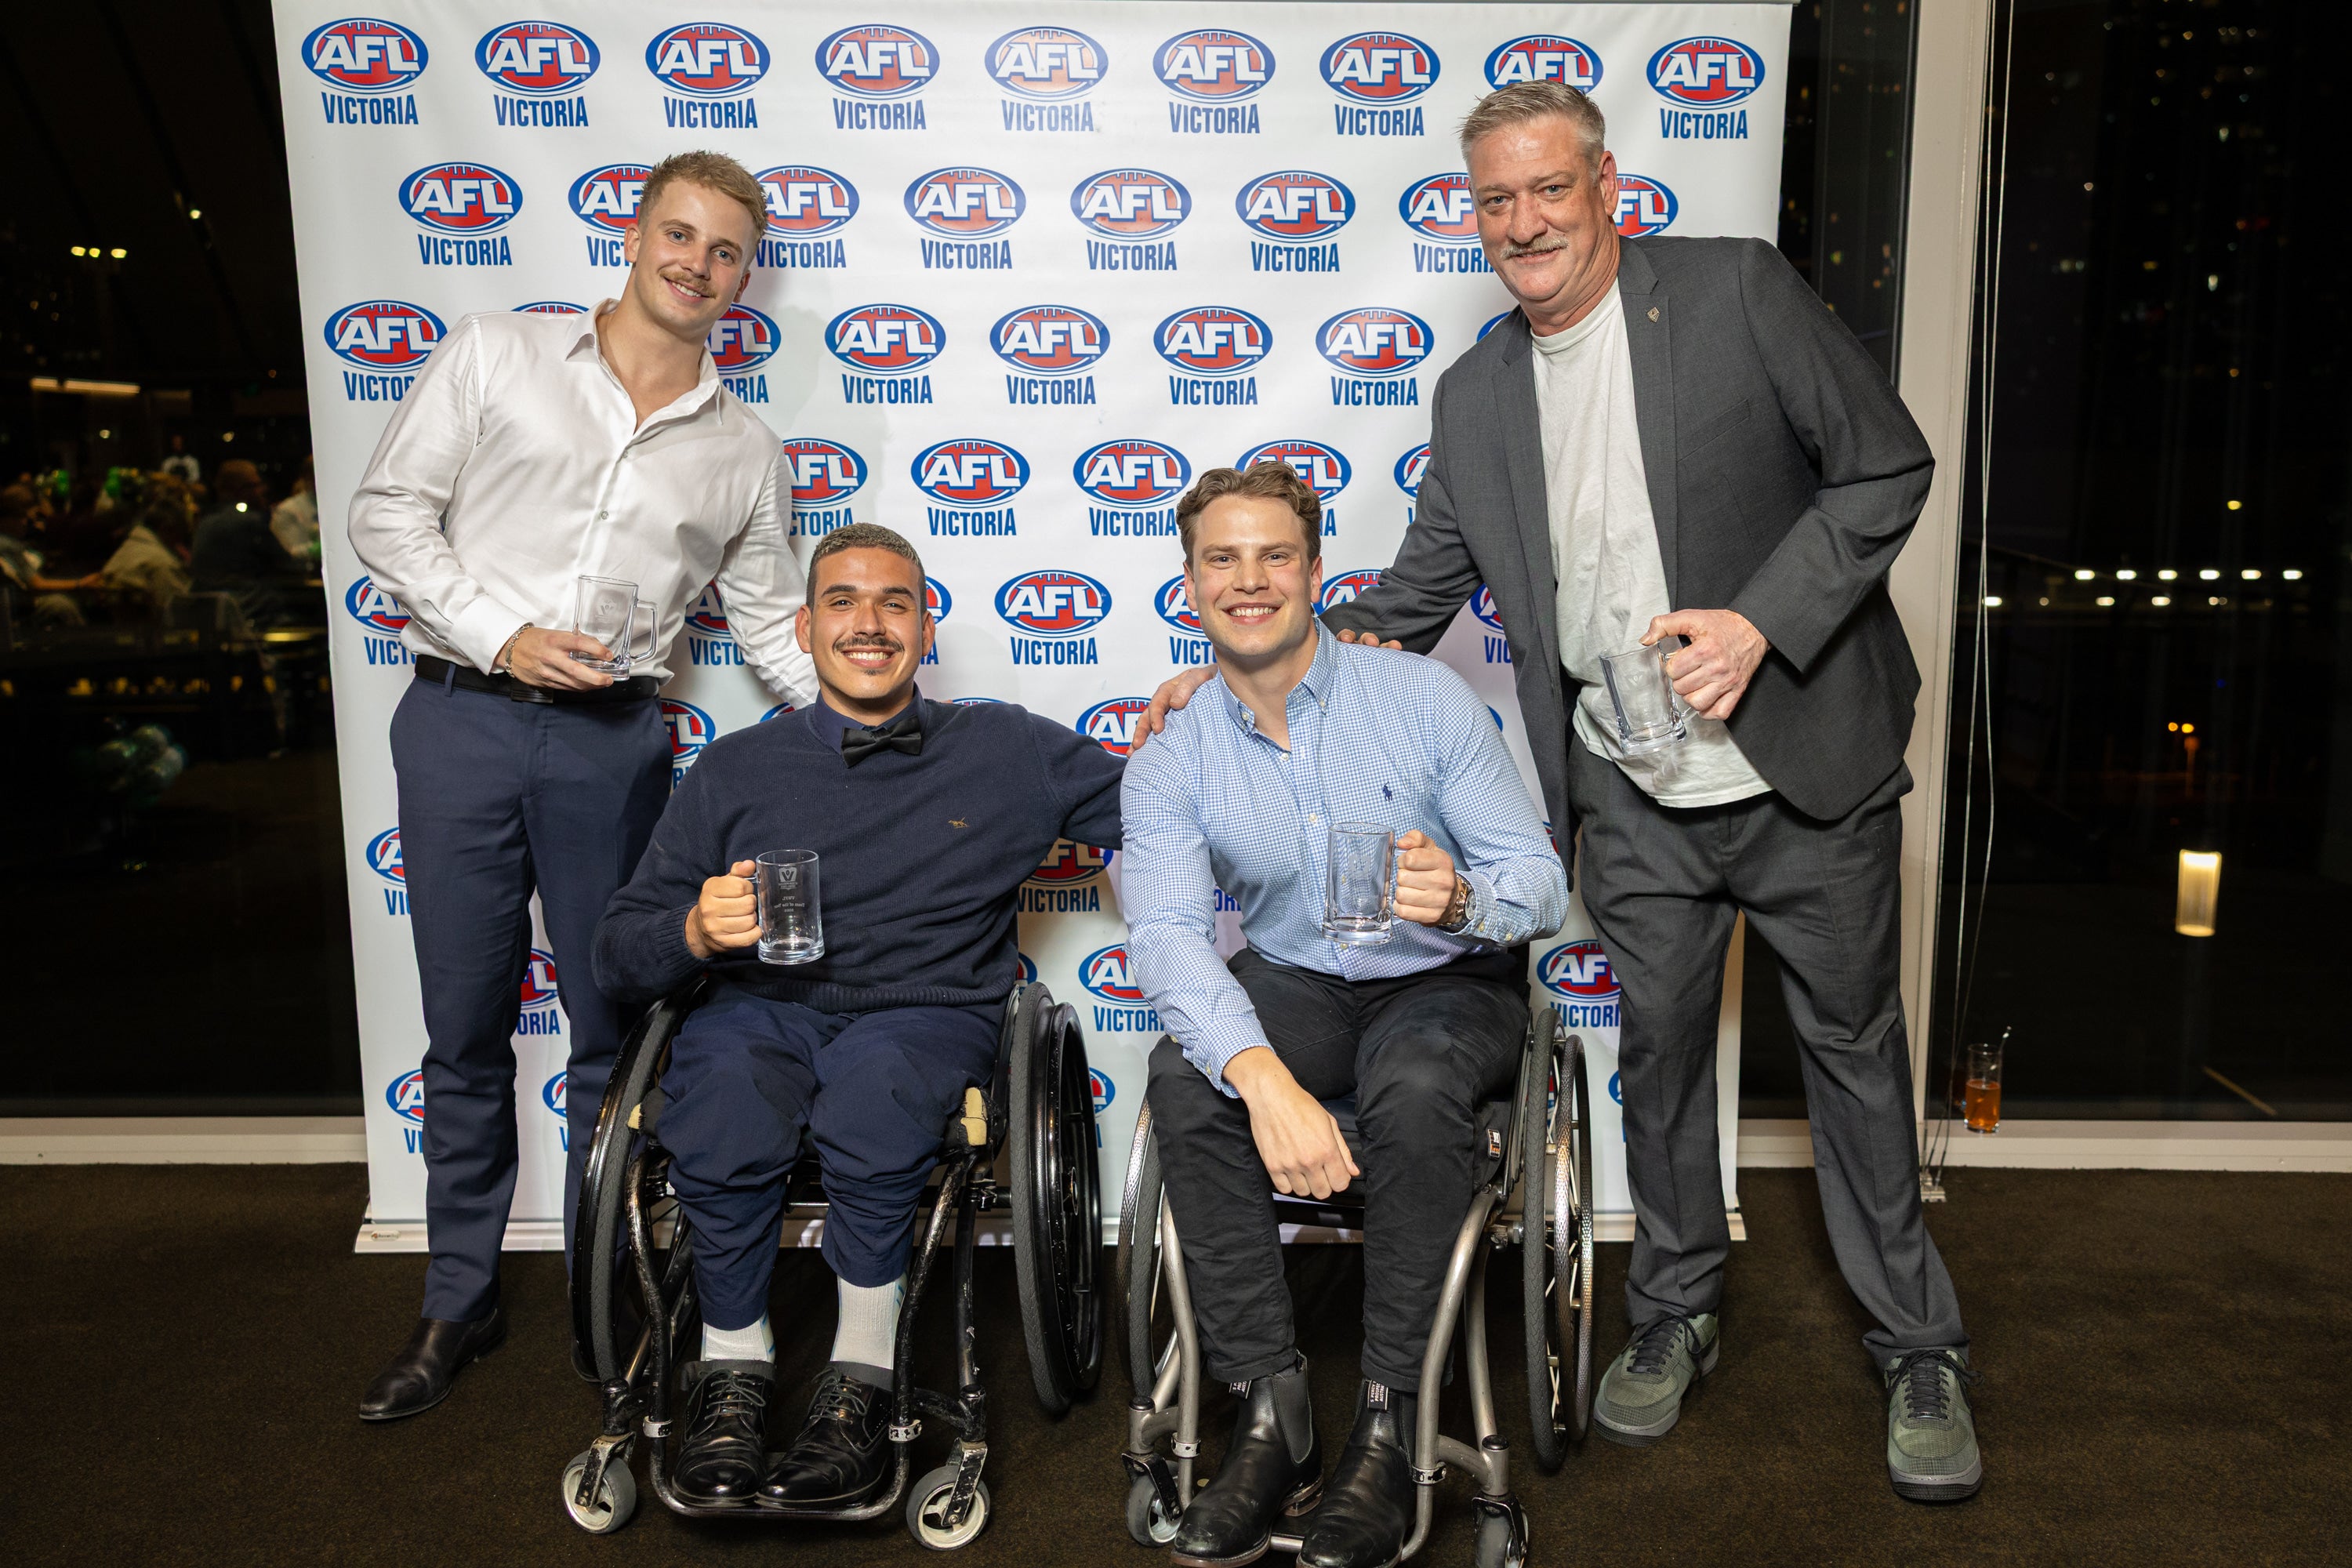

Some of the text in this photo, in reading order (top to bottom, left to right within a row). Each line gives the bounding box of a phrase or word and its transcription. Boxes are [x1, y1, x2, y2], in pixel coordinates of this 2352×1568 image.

[313, 35, 420, 71] AFL
[486, 38, 592, 74] AFL
[655, 40, 761, 75] AFL
[826, 42, 931, 77] AFL
[996, 44, 1100, 79] AFL
[1163, 46, 1266, 81] AFL
[1329, 49, 1432, 84] AFL
[1494, 52, 1595, 85] AFL
[1655, 53, 1756, 87] AFL
[321, 93, 419, 125] VICTORIA
[493, 95, 589, 127] VICTORIA
[663, 97, 758, 128] VICTORIA
[832, 98, 927, 130] VICTORIA
[1001, 100, 1094, 132] VICTORIA
[1168, 102, 1260, 133] VICTORIA
[1334, 105, 1425, 136] VICTORIA
[1660, 109, 1748, 140] VICTORIA
[409, 180, 514, 214] AFL
[579, 181, 644, 216] AF
[914, 184, 1018, 219] AFL
[1080, 185, 1183, 220] AFL
[1246, 187, 1347, 222] AFL
[1409, 189, 1478, 223] AF
[1617, 191, 1670, 225] FL
[417, 234, 512, 266] VICTORIA
[586, 236, 628, 267] VICT
[757, 239, 847, 269] VICTORIA
[920, 238, 1012, 270] VICTORIA
[1086, 240, 1177, 270] VICTORIA
[1251, 241, 1340, 272] VICTORIA
[335, 318, 439, 351] AFL
[706, 321, 772, 354] FL
[835, 321, 938, 355] AFL
[1000, 321, 1102, 355] AFL
[1163, 322, 1265, 356] AFL
[1326, 324, 1425, 357] AFL
[841, 373, 933, 405] VICTORIA
[1006, 375, 1096, 405] VICTORIA
[1169, 376, 1258, 405] VICTORIA
[1330, 376, 1418, 406] VICTORIA
[920, 455, 1022, 488] AFL
[1083, 456, 1182, 488] AFL
[789, 508, 854, 535] CTORIA
[927, 507, 1016, 536] VICTORIA
[1088, 508, 1176, 536] VICTORIA
[1004, 586, 1103, 619] AFL
[365, 637, 416, 665] VICT
[690, 637, 746, 666] VICTO
[1010, 637, 1098, 666] VICTORIA
[1171, 637, 1218, 665] VICT
[1018, 886, 1099, 913] VICTORIA
[1546, 954, 1621, 985] AF
